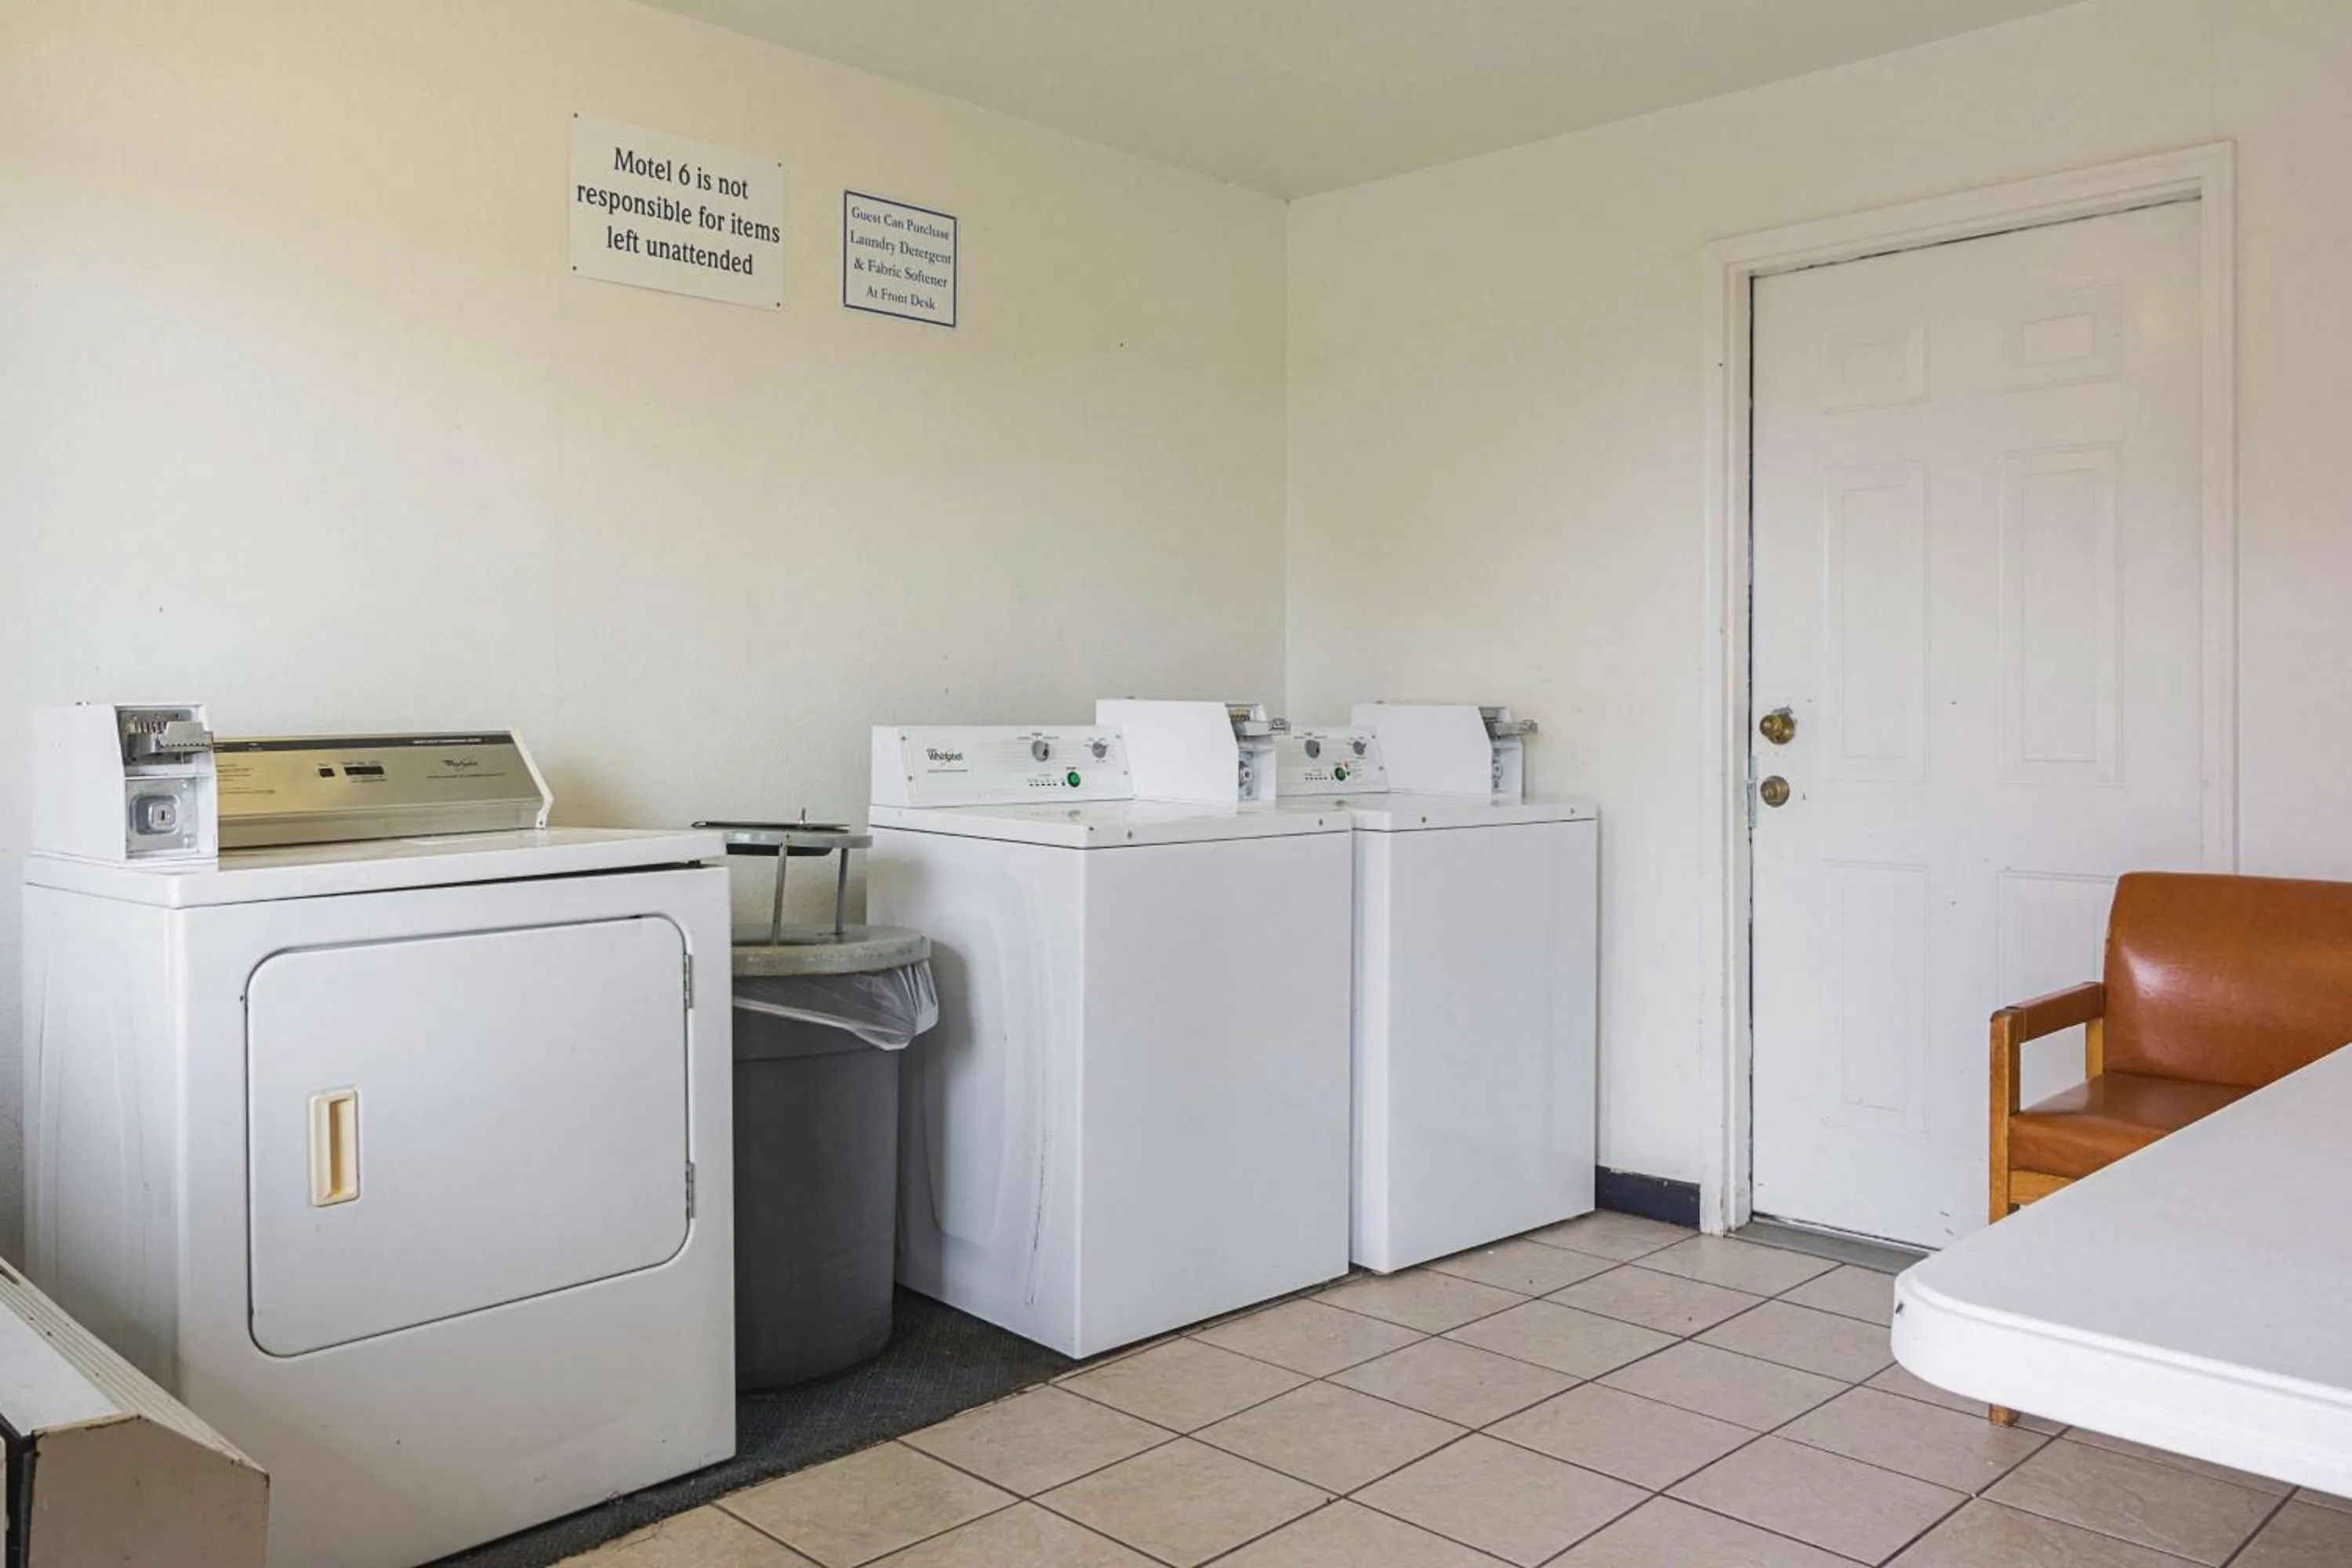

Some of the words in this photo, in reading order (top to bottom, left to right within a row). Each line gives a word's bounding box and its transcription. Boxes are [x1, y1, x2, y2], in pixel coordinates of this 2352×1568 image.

[614, 147, 671, 182] Motel
[679, 164, 691, 186] 6
[697, 167, 711, 191] is
[718, 176, 749, 199] not
[577, 184, 692, 225] responsible
[699, 205, 725, 231] for
[731, 212, 780, 243] items
[851, 206, 881, 223] Guest
[884, 214, 904, 229] Can
[907, 219, 949, 240] Purchase
[607, 226, 640, 253] left
[646, 238, 753, 275] unattended
[850, 230, 896, 256] Laundry
[900, 241, 952, 264] Detergent
[854, 257, 864, 270] &
[868, 260, 902, 278] Fabric
[905, 267, 948, 288] Softener
[866, 285, 878, 298] At
[881, 288, 908, 303] Front
[910, 294, 935, 310] Desk
